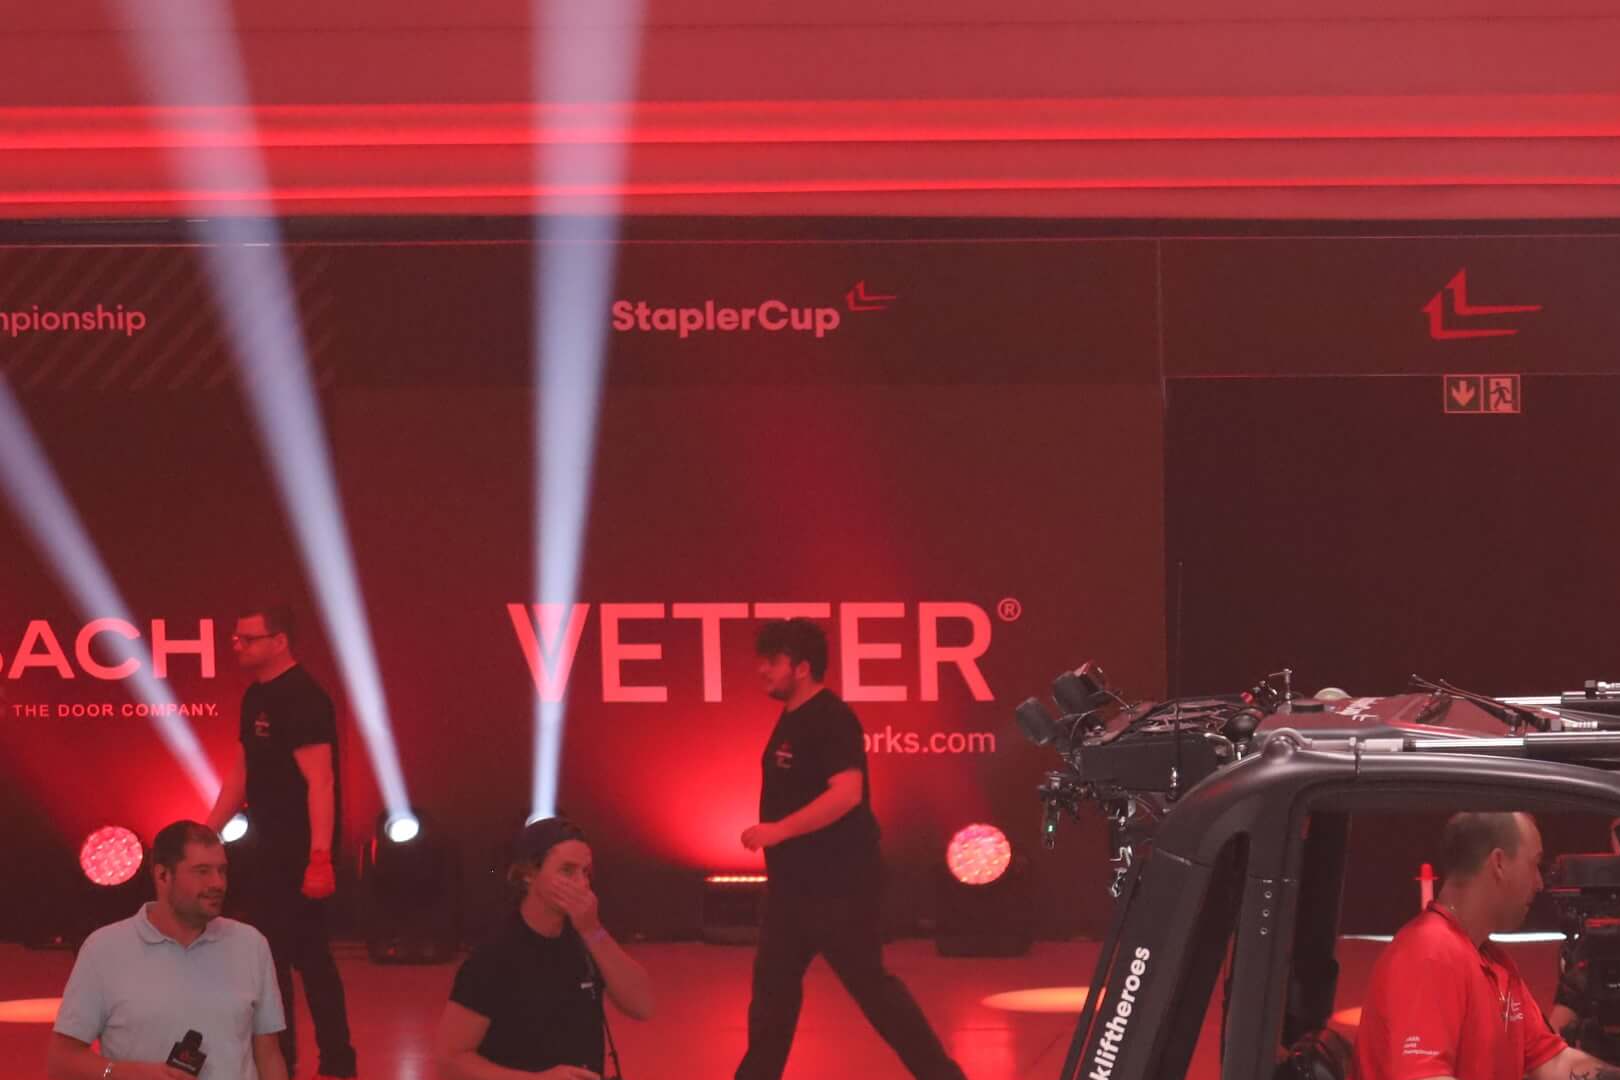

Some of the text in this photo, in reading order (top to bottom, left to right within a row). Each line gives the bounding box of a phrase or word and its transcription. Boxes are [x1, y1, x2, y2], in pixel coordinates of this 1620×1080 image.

[611, 300, 840, 338] StaplerCup
[0, 618, 216, 680] ACH
[13, 703, 219, 717] THE DOOR COMPANY.
[863, 725, 996, 753] rks.com
